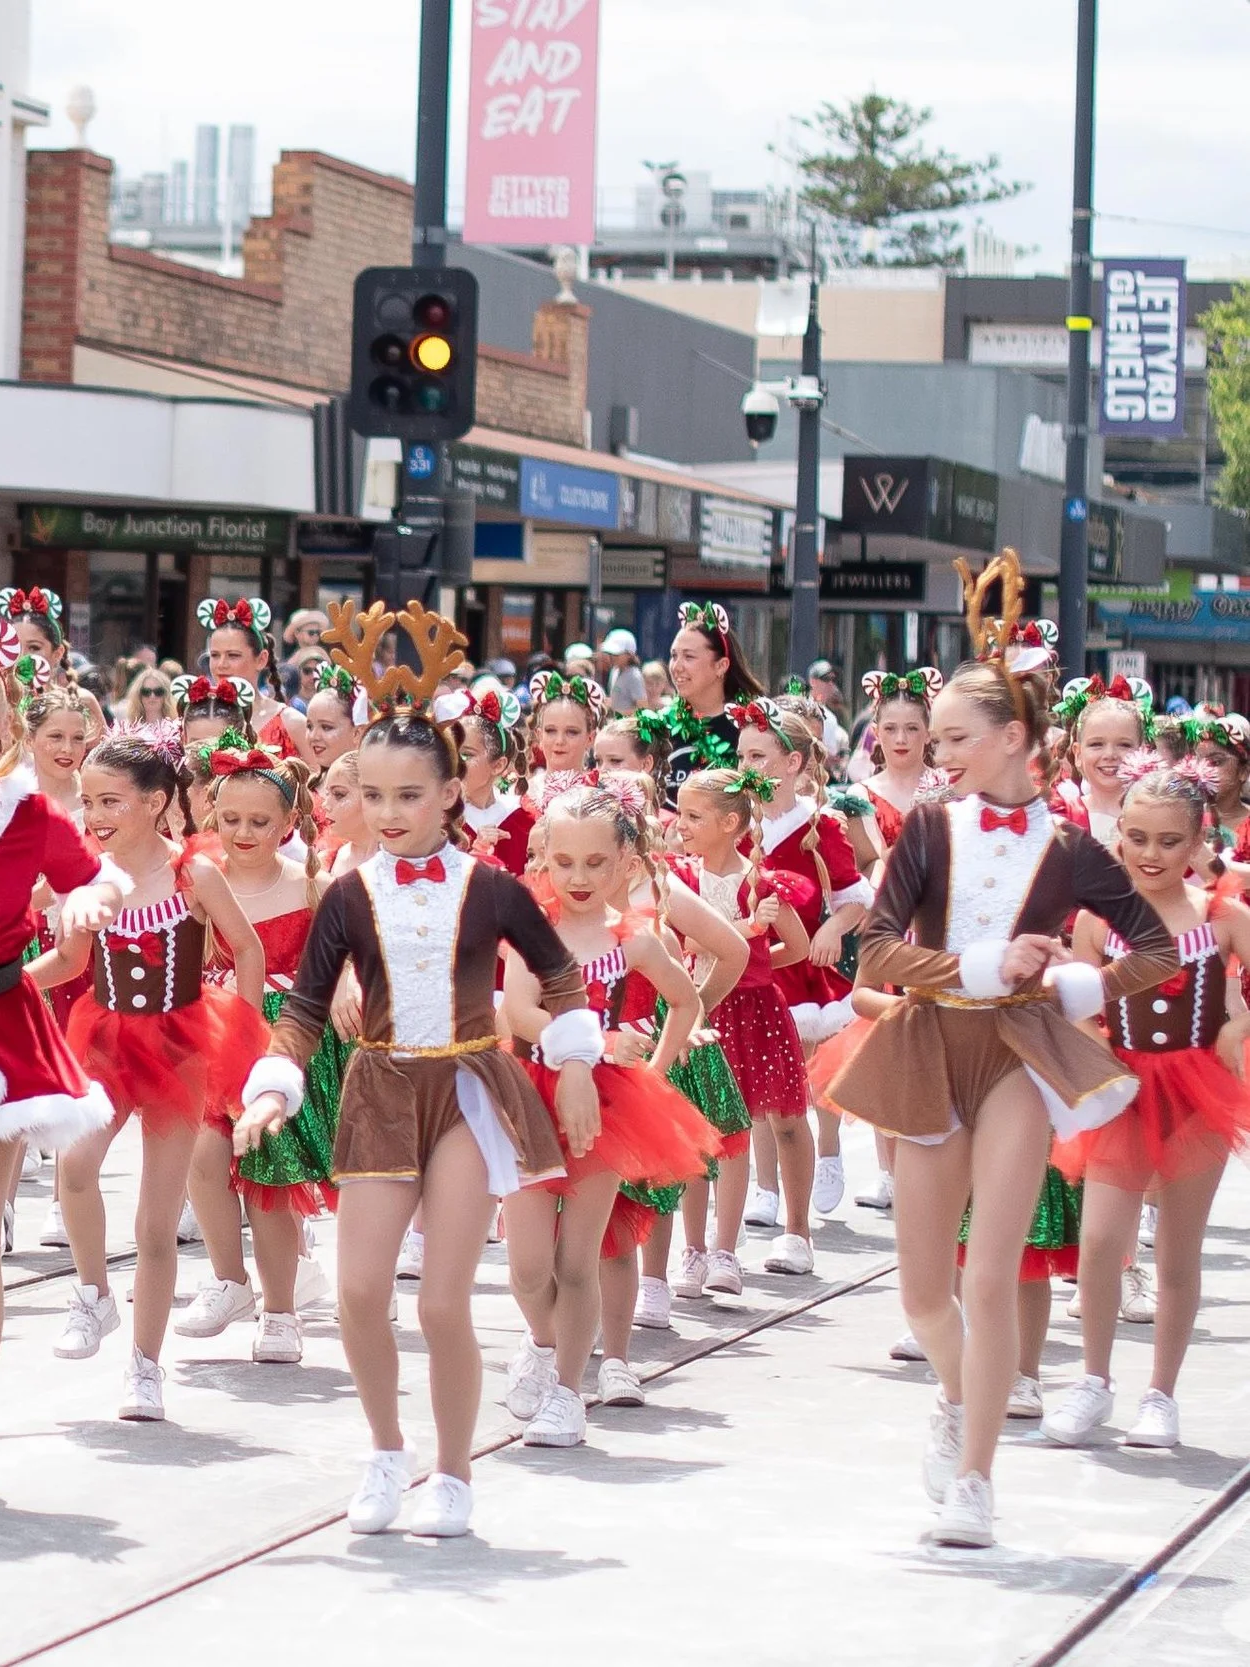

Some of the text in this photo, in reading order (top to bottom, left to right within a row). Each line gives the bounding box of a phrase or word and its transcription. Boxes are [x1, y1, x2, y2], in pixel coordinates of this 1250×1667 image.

[475, 0, 586, 32] STAY
[484, 36, 582, 87] AND
[481, 84, 582, 140] EAT
[1106, 270, 1146, 422] GLENELG
[81, 511, 267, 539] Bay Junction Florist
[831, 571, 912, 589] JEWELLERS
